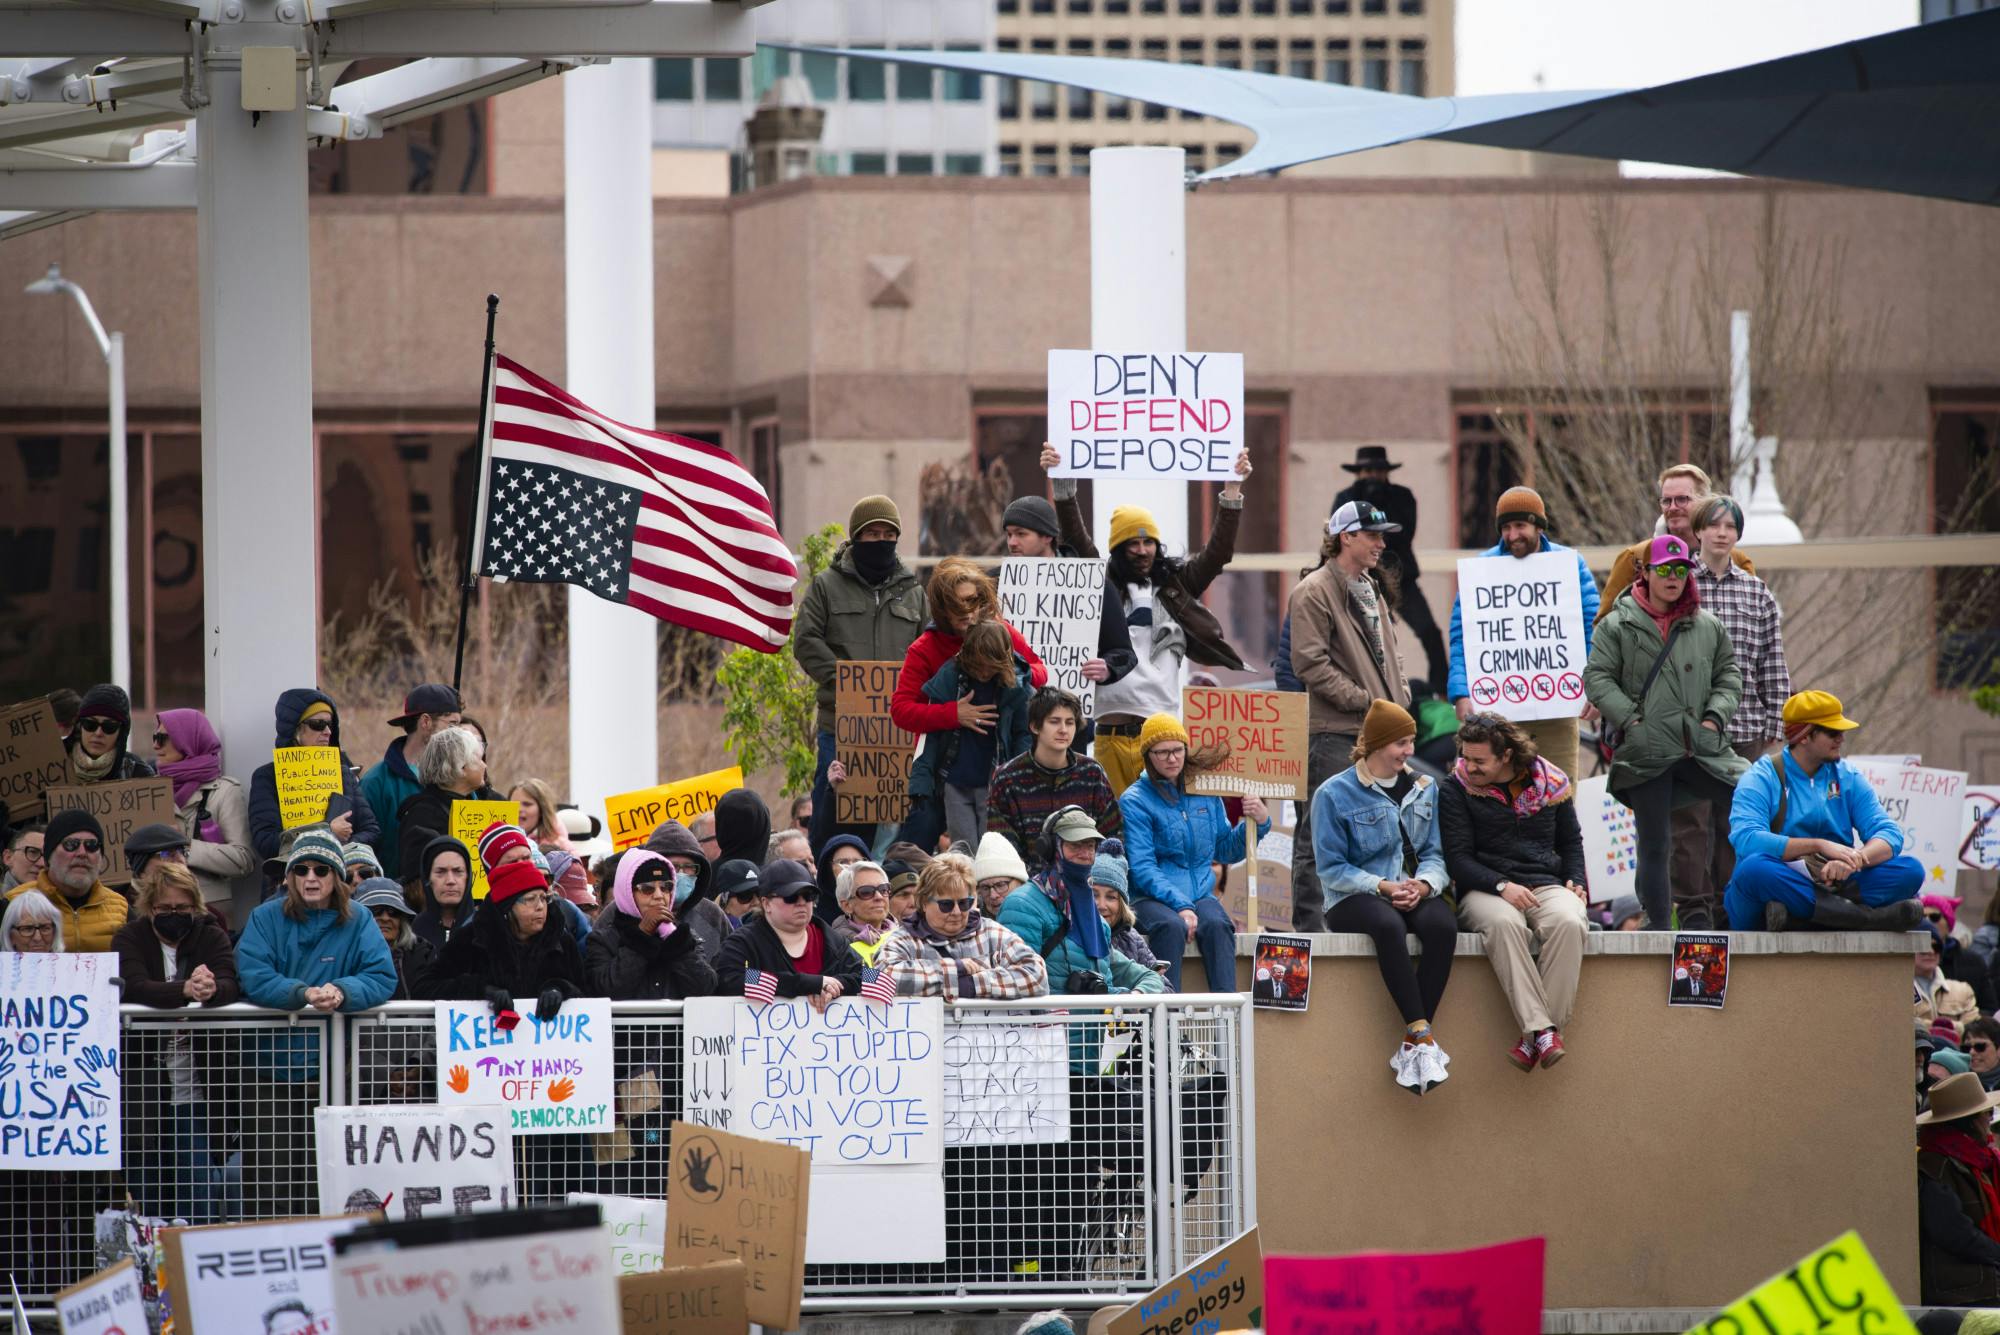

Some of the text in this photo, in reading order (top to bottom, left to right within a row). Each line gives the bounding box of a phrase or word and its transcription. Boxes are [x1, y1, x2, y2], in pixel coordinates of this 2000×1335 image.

[1094, 355, 1207, 399] DENY
[1070, 399, 1231, 433] DEFEND
[1070, 438, 1231, 472] DEPOSE
[1004, 563, 1105, 590] NO FASCISTS
[1002, 593, 1103, 620] NO KINGS!
[1476, 581, 1562, 610] DEPORT
[1477, 615, 1567, 643] THE REAL
[1036, 646, 1090, 667] AUGHS
[1480, 644, 1569, 674] CRIMINALS
[839, 665, 902, 693] PROT
[1055, 668, 1089, 690] YOU
[1187, 691, 1280, 723] SPINES
[1189, 726, 1286, 752] FOR SALE
[277, 750, 337, 763] HANDS OFF!
[1256, 758, 1302, 777] WITHIN
[0, 760, 69, 798] OCRACY
[281, 765, 337, 779] PUBLIC LANDS
[304, 780, 338, 791] SCHOOLS
[877, 779, 904, 794] OUR
[49, 790, 112, 815] HANDS
[309, 808, 326, 817] DAT
[459, 804, 484, 826] KEEP
[838, 795, 912, 822] DEMOCR
[106, 820, 133, 846] UR
[0, 995, 89, 1029] ANDS
[747, 1003, 810, 1037] YOU
[526, 1009, 592, 1044] YOUR
[18, 1032, 80, 1055] OFF
[692, 1035, 734, 1056] DUMP
[742, 1030, 931, 1065] FIX STUPID
[26, 1058, 67, 1079] the
[476, 1057, 583, 1077] TINY HANDS
[502, 1080, 542, 1100] OFF
[751, 1098, 929, 1130] CAN VOTE
[3, 1125, 109, 1157] PLEASE
[344, 1122, 496, 1165] HANDS
[839, 1132, 923, 1160] OUT
[729, 1151, 797, 1199] HANDS
[738, 1198, 778, 1230] OFF
[196, 1245, 327, 1280] RESIS
[623, 1286, 723, 1325] SCIENCE
[1138, 1276, 1246, 1335] Theology
[1140, 1259, 1231, 1326] Keep Your
